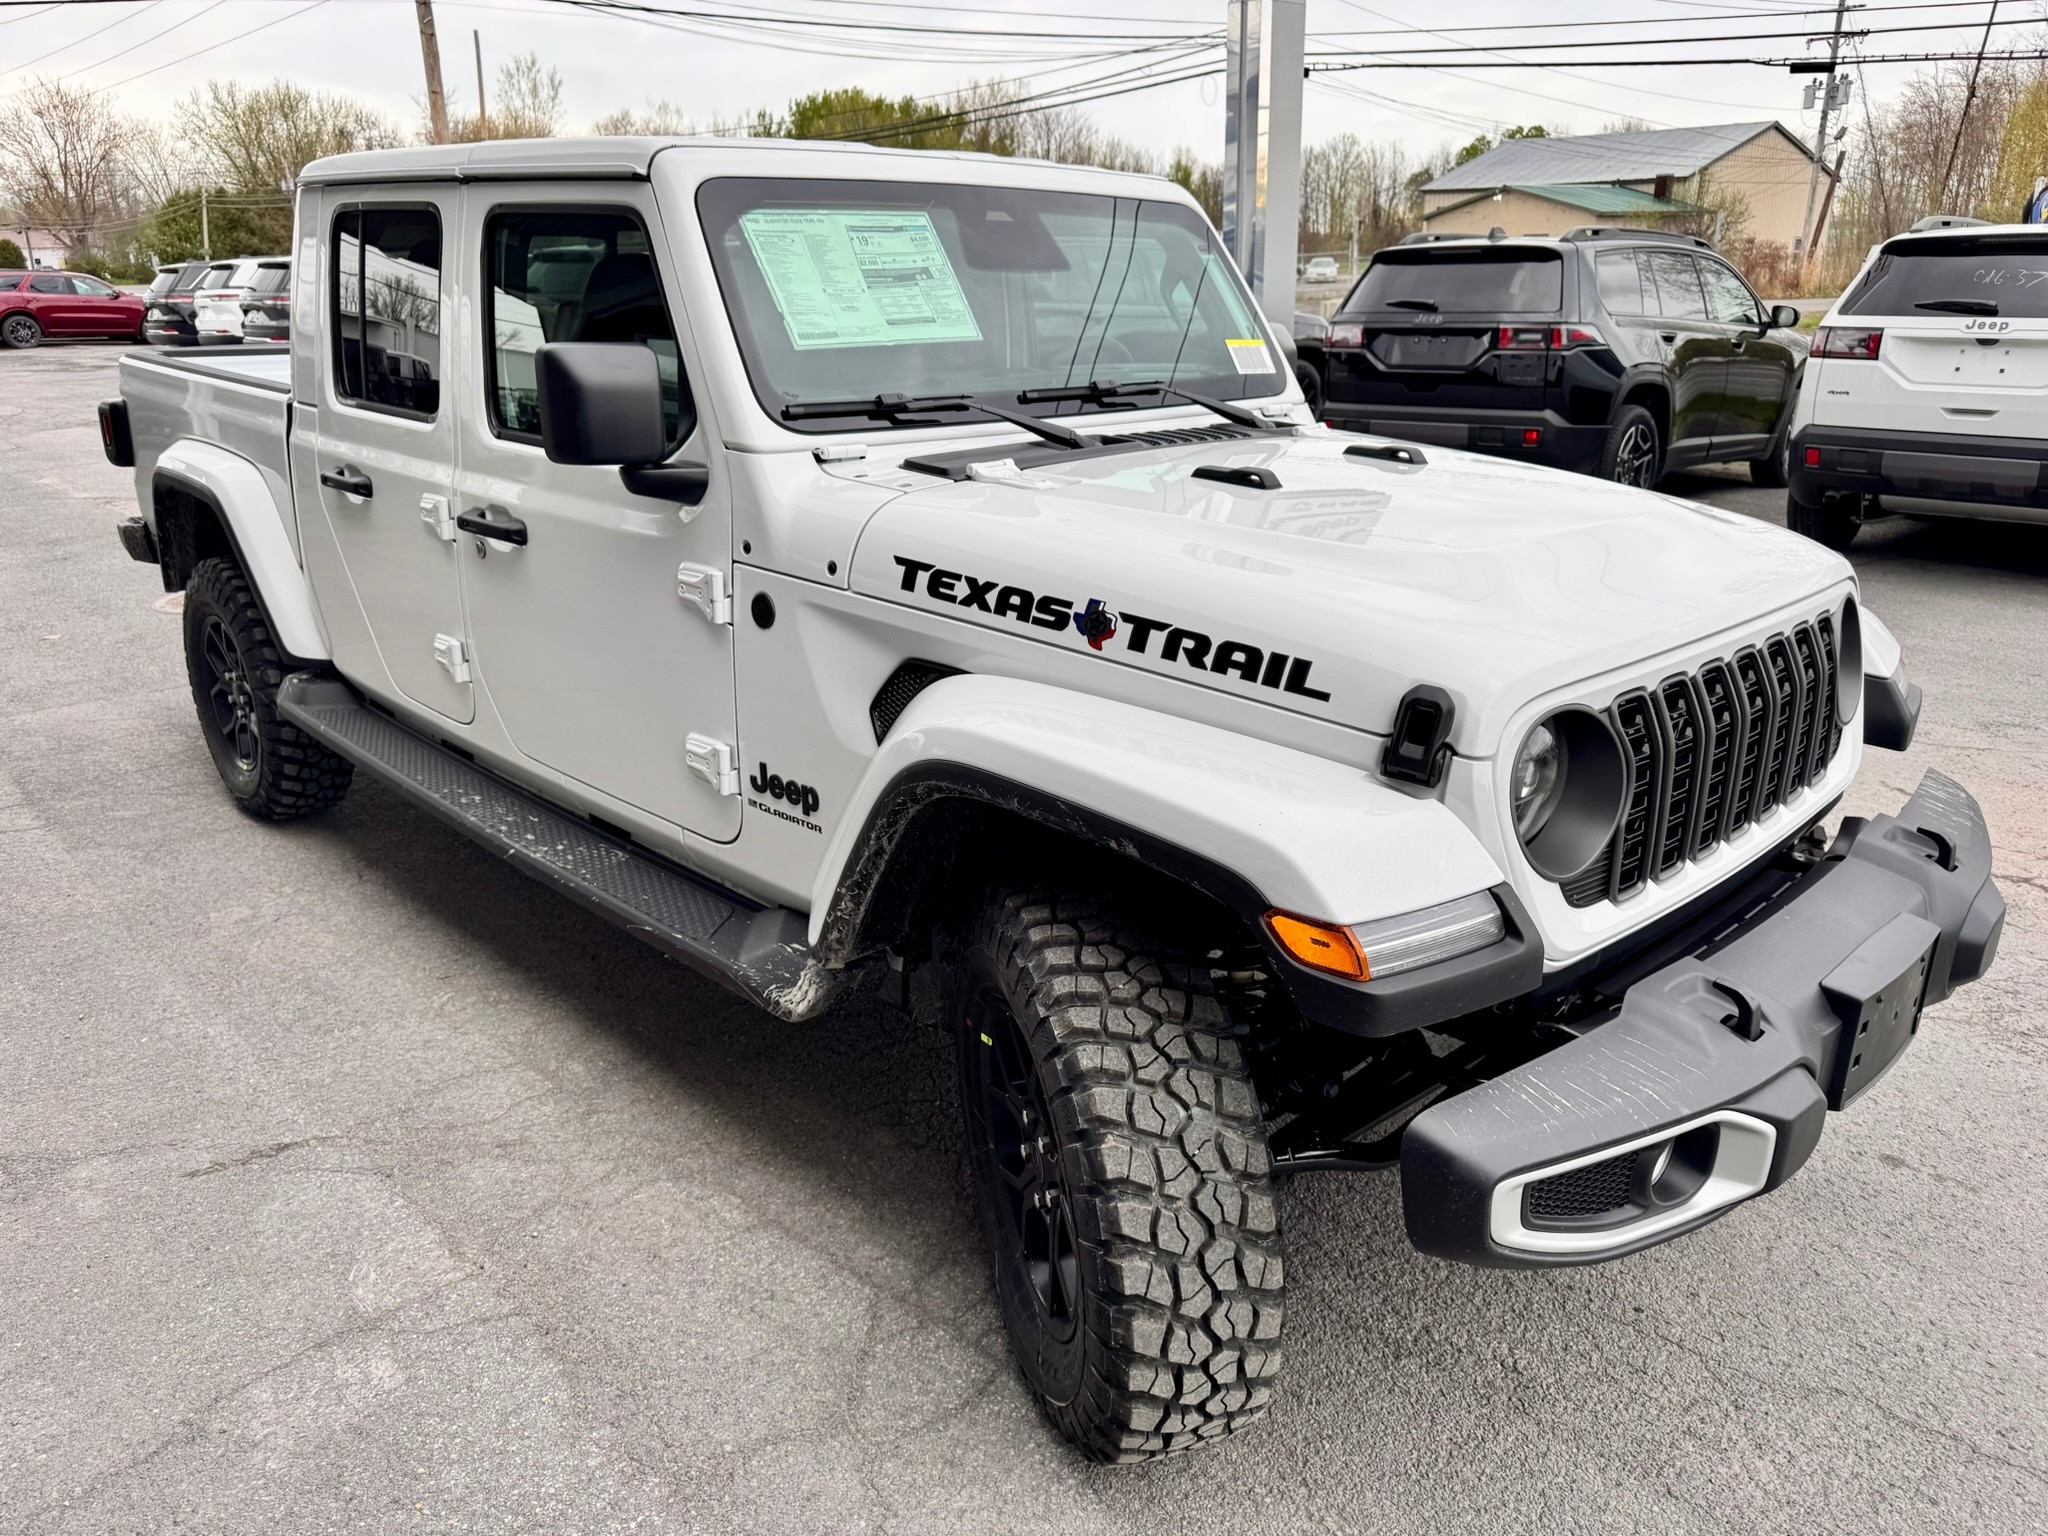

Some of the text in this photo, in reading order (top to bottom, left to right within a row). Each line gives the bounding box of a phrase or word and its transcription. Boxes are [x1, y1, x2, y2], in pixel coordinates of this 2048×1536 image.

[856, 235, 869, 246] 19
[1414, 313, 1444, 324] Jeep
[1965, 319, 2010, 332] Jeep
[893, 555, 1331, 702] TEXAS TRAIL
[749, 761, 820, 817] Jeep
[759, 802, 823, 834] GLADIATOR
